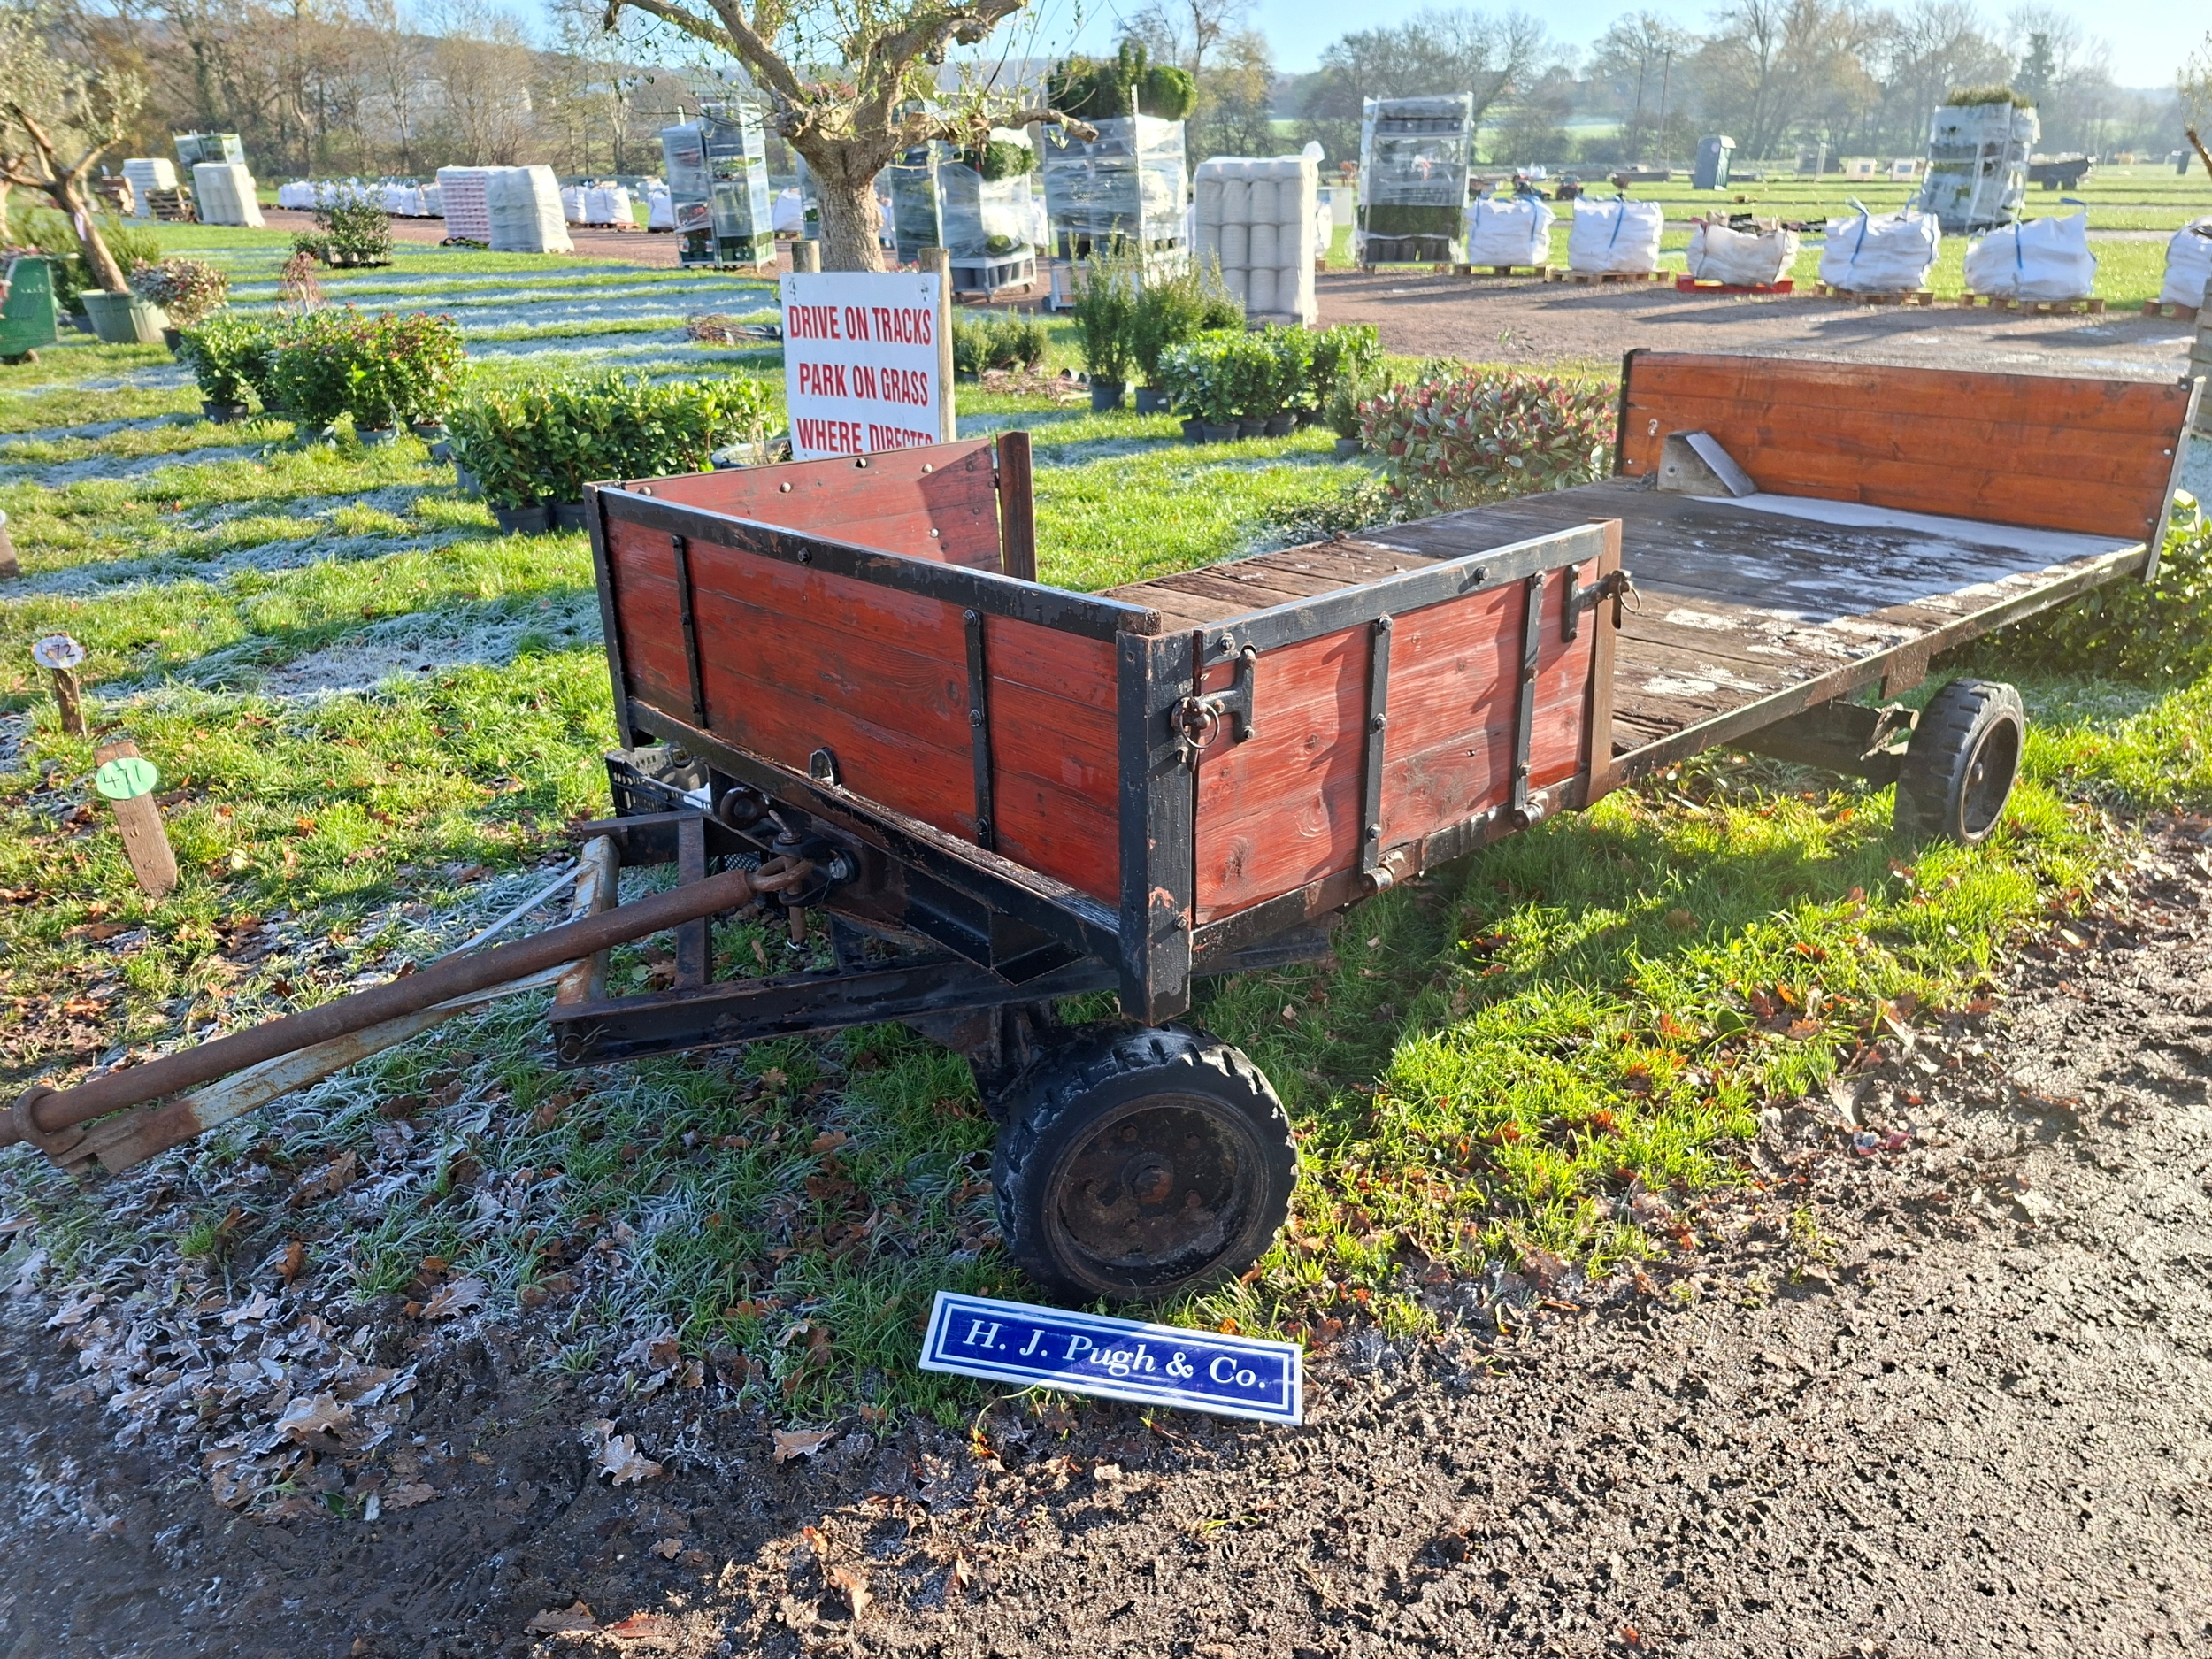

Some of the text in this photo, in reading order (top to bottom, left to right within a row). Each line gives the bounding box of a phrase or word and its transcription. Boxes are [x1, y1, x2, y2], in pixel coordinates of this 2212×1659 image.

[788, 305, 932, 345] DRIVE ON TRACKS
[799, 363, 929, 407] PARK ON GRASS
[796, 418, 864, 454] WHERE
[102, 764, 142, 789] 471
[962, 1318, 1266, 1389] H. J. Pugh & Co.
